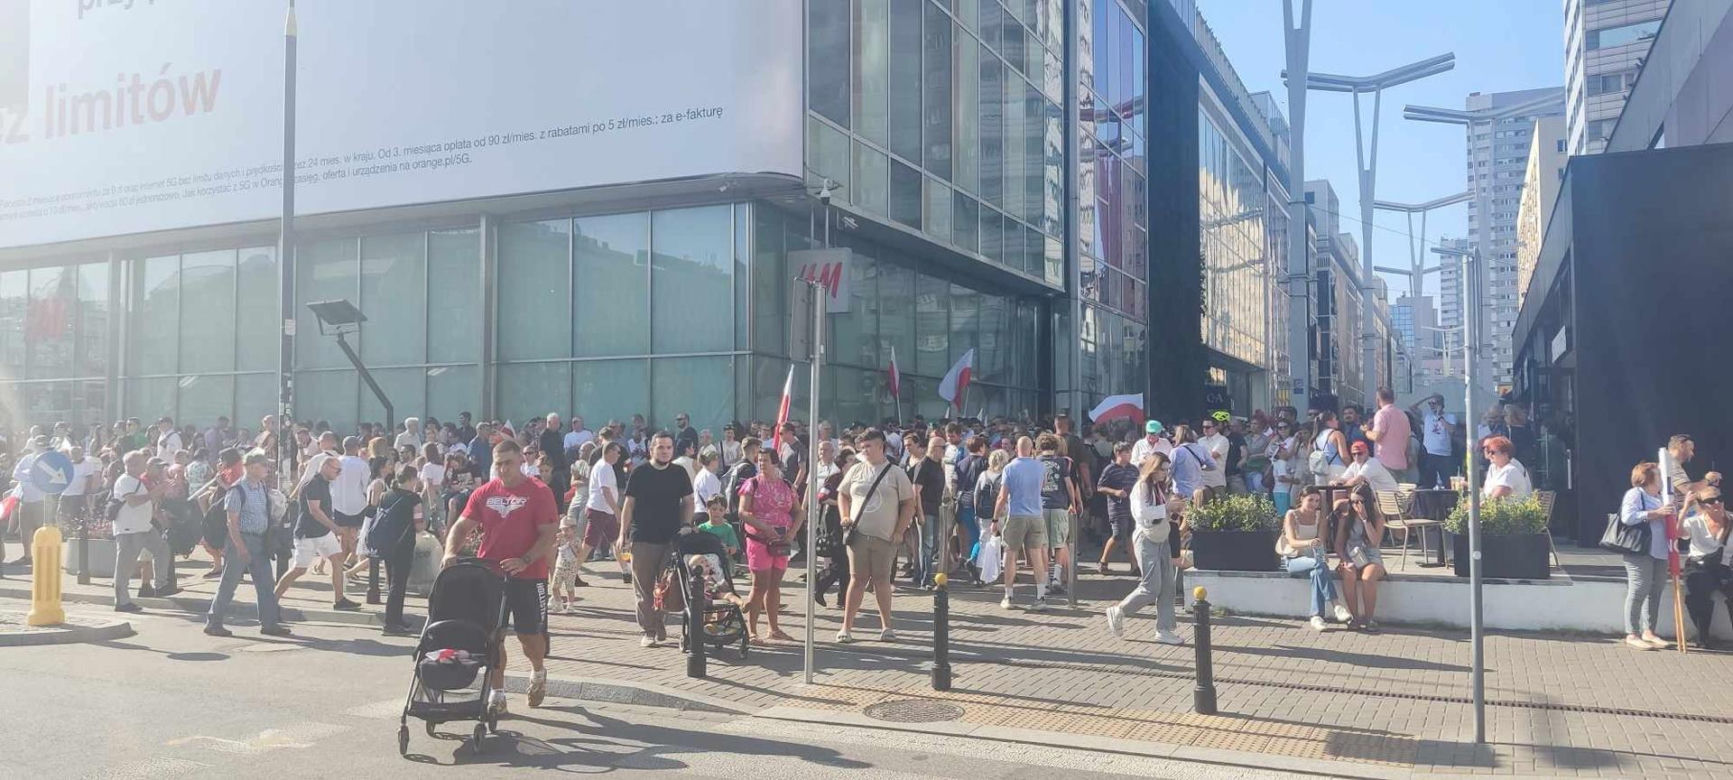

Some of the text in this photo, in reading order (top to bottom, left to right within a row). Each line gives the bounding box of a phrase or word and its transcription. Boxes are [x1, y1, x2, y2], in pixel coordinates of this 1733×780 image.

[45, 61, 222, 139] limitów
[378, 147, 391, 159] Od
[392, 146, 401, 158] 3.
[474, 135, 486, 147] od
[488, 134, 500, 146] 90
[540, 130, 545, 140] z
[548, 122, 590, 138] rabatami
[592, 121, 606, 135] po
[608, 119, 615, 131] 5
[661, 113, 673, 124] za
[676, 106, 723, 121] e-fakturę
[399, 160, 410, 171] na
